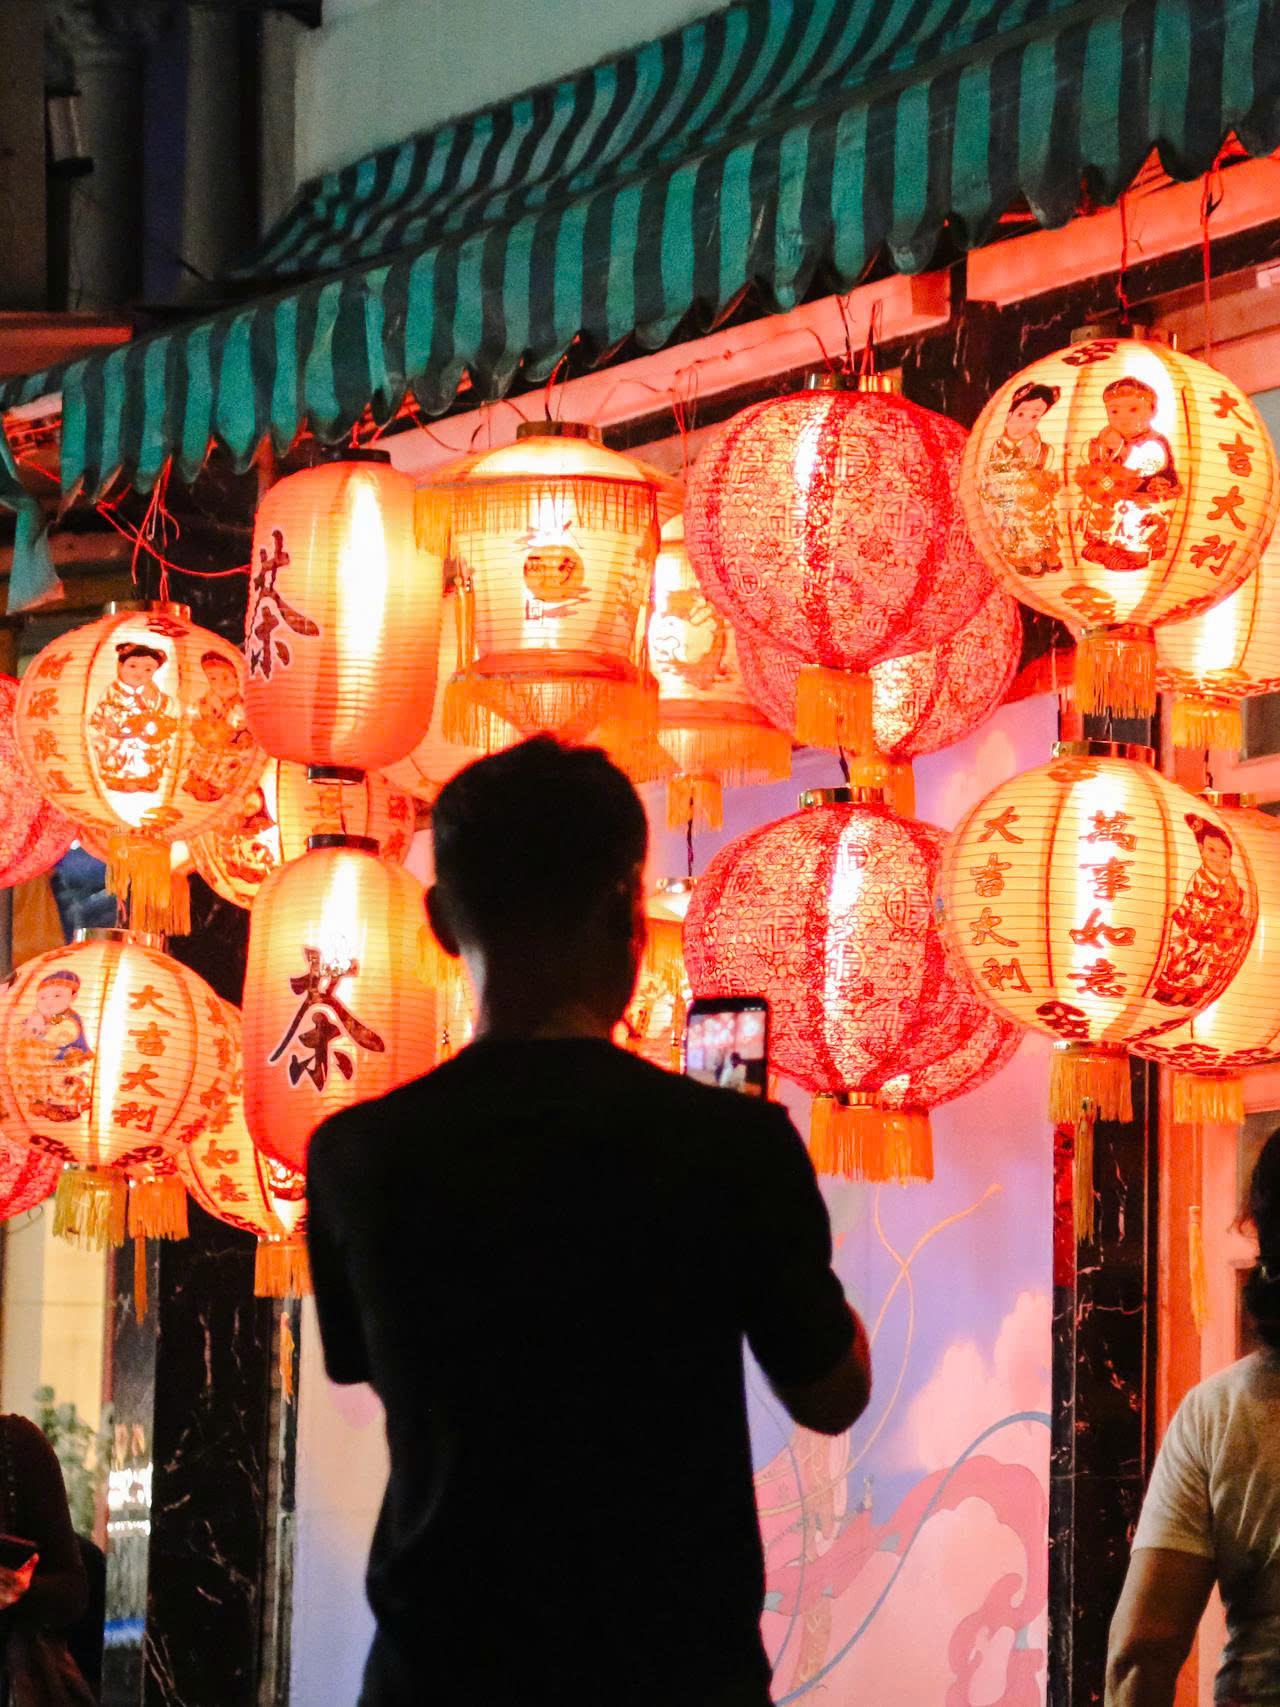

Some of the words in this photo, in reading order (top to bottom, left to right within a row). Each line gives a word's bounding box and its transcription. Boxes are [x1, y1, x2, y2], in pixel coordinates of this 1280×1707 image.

[1189, 390, 1256, 577] 大吉大利
[248, 530, 320, 681] 茶
[968, 806, 1033, 994] 大吉大利
[1066, 810, 1138, 998] 萬事如意
[111, 983, 178, 1132] 大吉大利
[269, 945, 385, 1092] 茶
